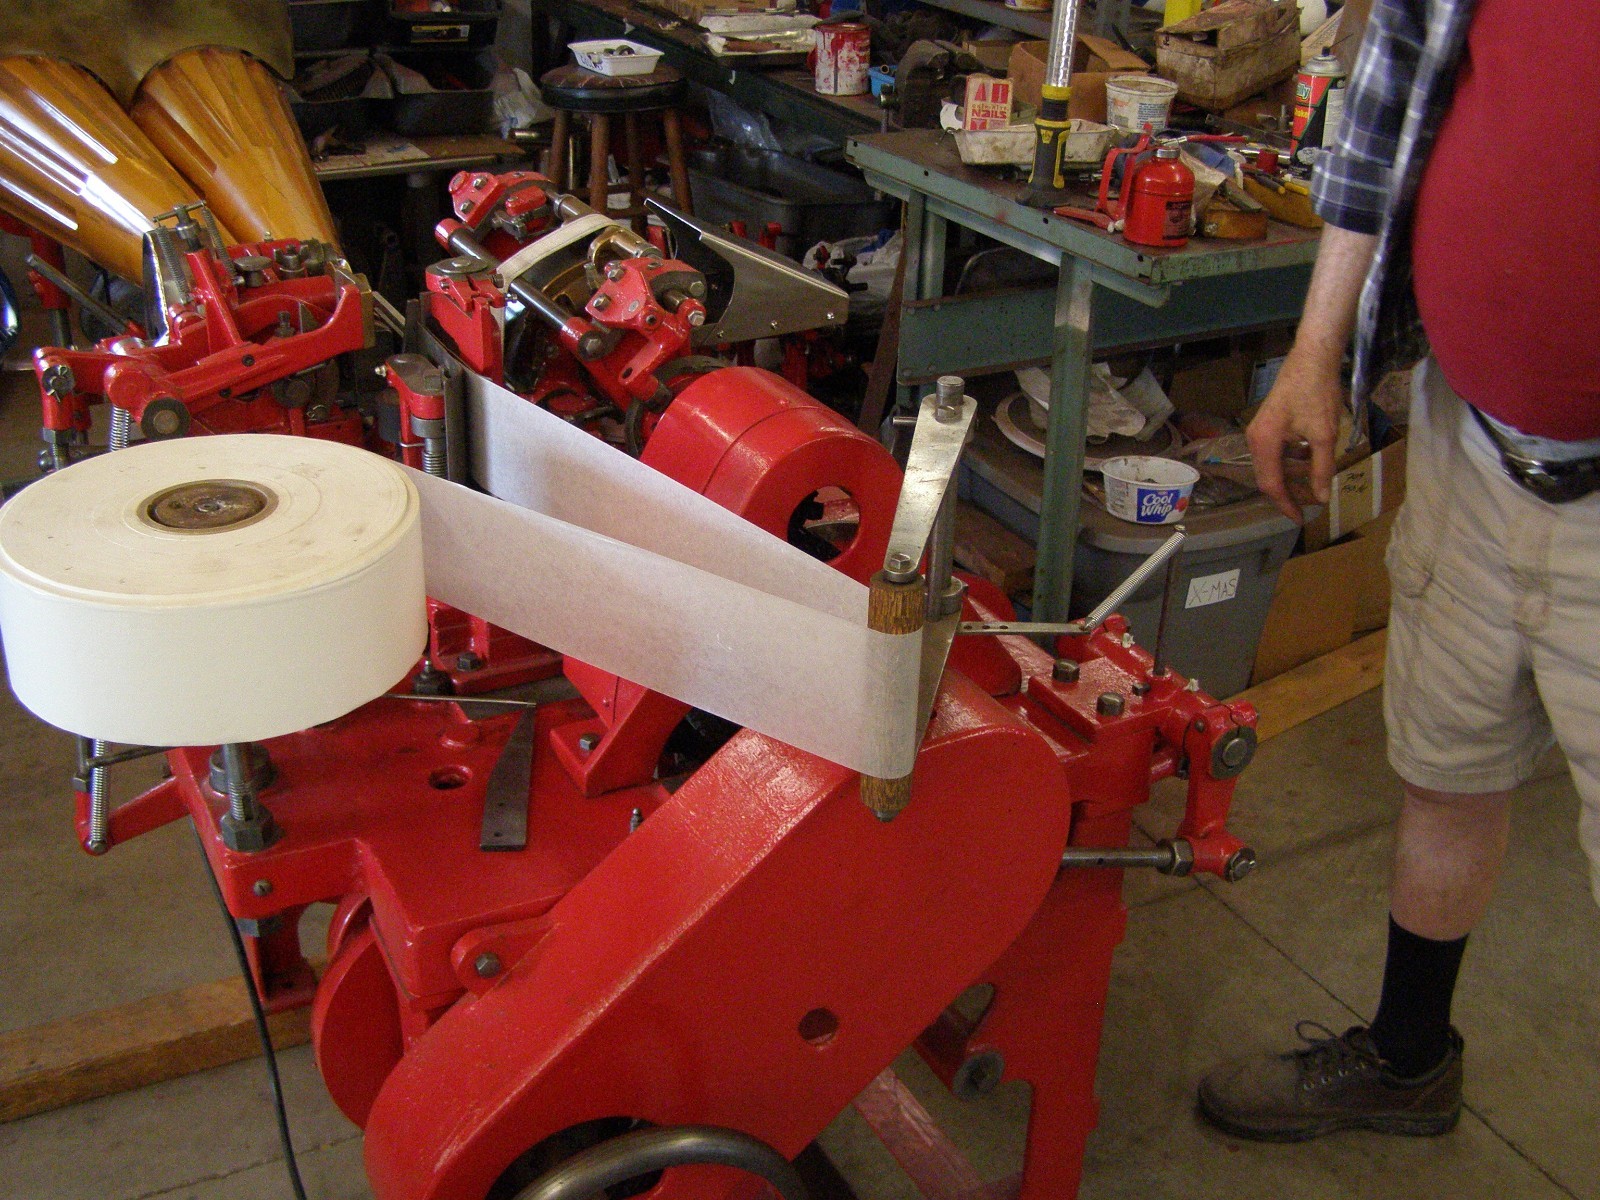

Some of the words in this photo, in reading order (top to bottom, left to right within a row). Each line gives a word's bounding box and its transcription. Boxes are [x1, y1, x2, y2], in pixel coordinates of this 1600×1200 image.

[1142, 493, 1174, 506] Cool
[1141, 503, 1173, 517] Whip
[1189, 578, 1237, 606] X-MAS
